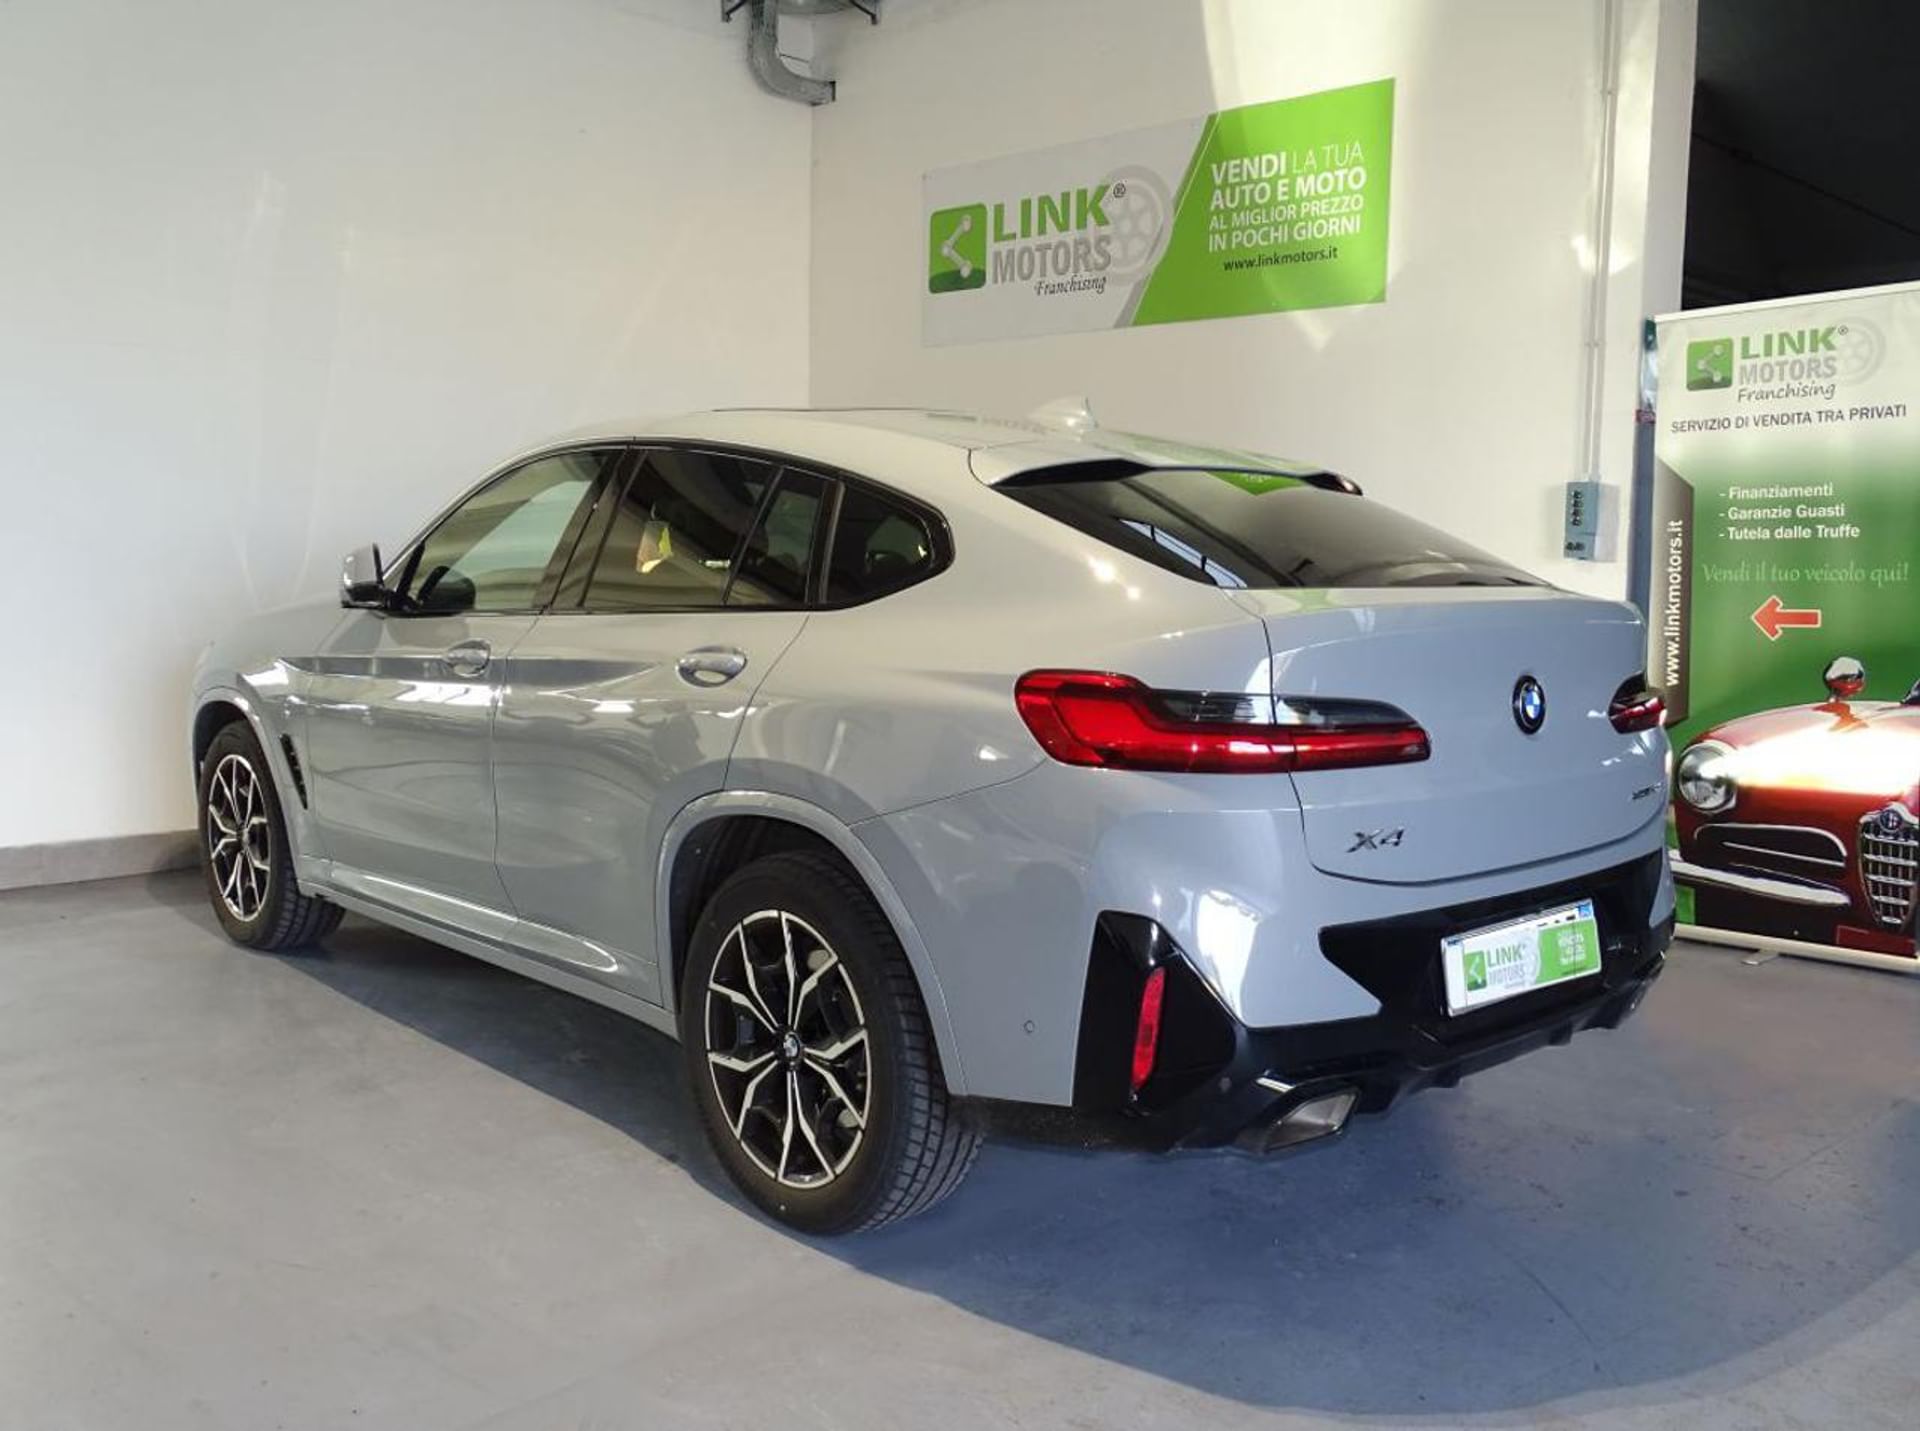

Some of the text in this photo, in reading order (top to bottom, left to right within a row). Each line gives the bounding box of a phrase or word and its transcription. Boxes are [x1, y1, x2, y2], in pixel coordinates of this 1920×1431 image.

[1211, 140, 1365, 185] VENDI LA TUA
[1210, 166, 1368, 211] AUTO E MOTO
[1209, 194, 1364, 231] AL MIGLIOR PREZZO
[1209, 215, 1361, 253] IN POCHI GIORNI
[992, 234, 1112, 285] MOTORS
[1223, 246, 1338, 271] www.linkmotors.it
[1034, 274, 1107, 296] Franchising
[1738, 356, 1838, 386] MOTORS
[1737, 382, 1836, 403] Franchising
[1671, 404, 1907, 433] SERVIZIO DI VENDITA TRA PRIVATI
[1728, 482, 1833, 501] Finanziamenti
[1727, 504, 1792, 520] Garanzie
[1796, 502, 1846, 519] Guasti
[1727, 525, 1770, 540] Tutela
[1774, 524, 1812, 539] dalle
[1815, 523, 1861, 538] Truffe
[1702, 560, 1910, 588] Vendi il tuo veicolo qui!
[1664, 519, 1683, 687] www.linkmotors.it
[1346, 829, 1404, 854] X4
